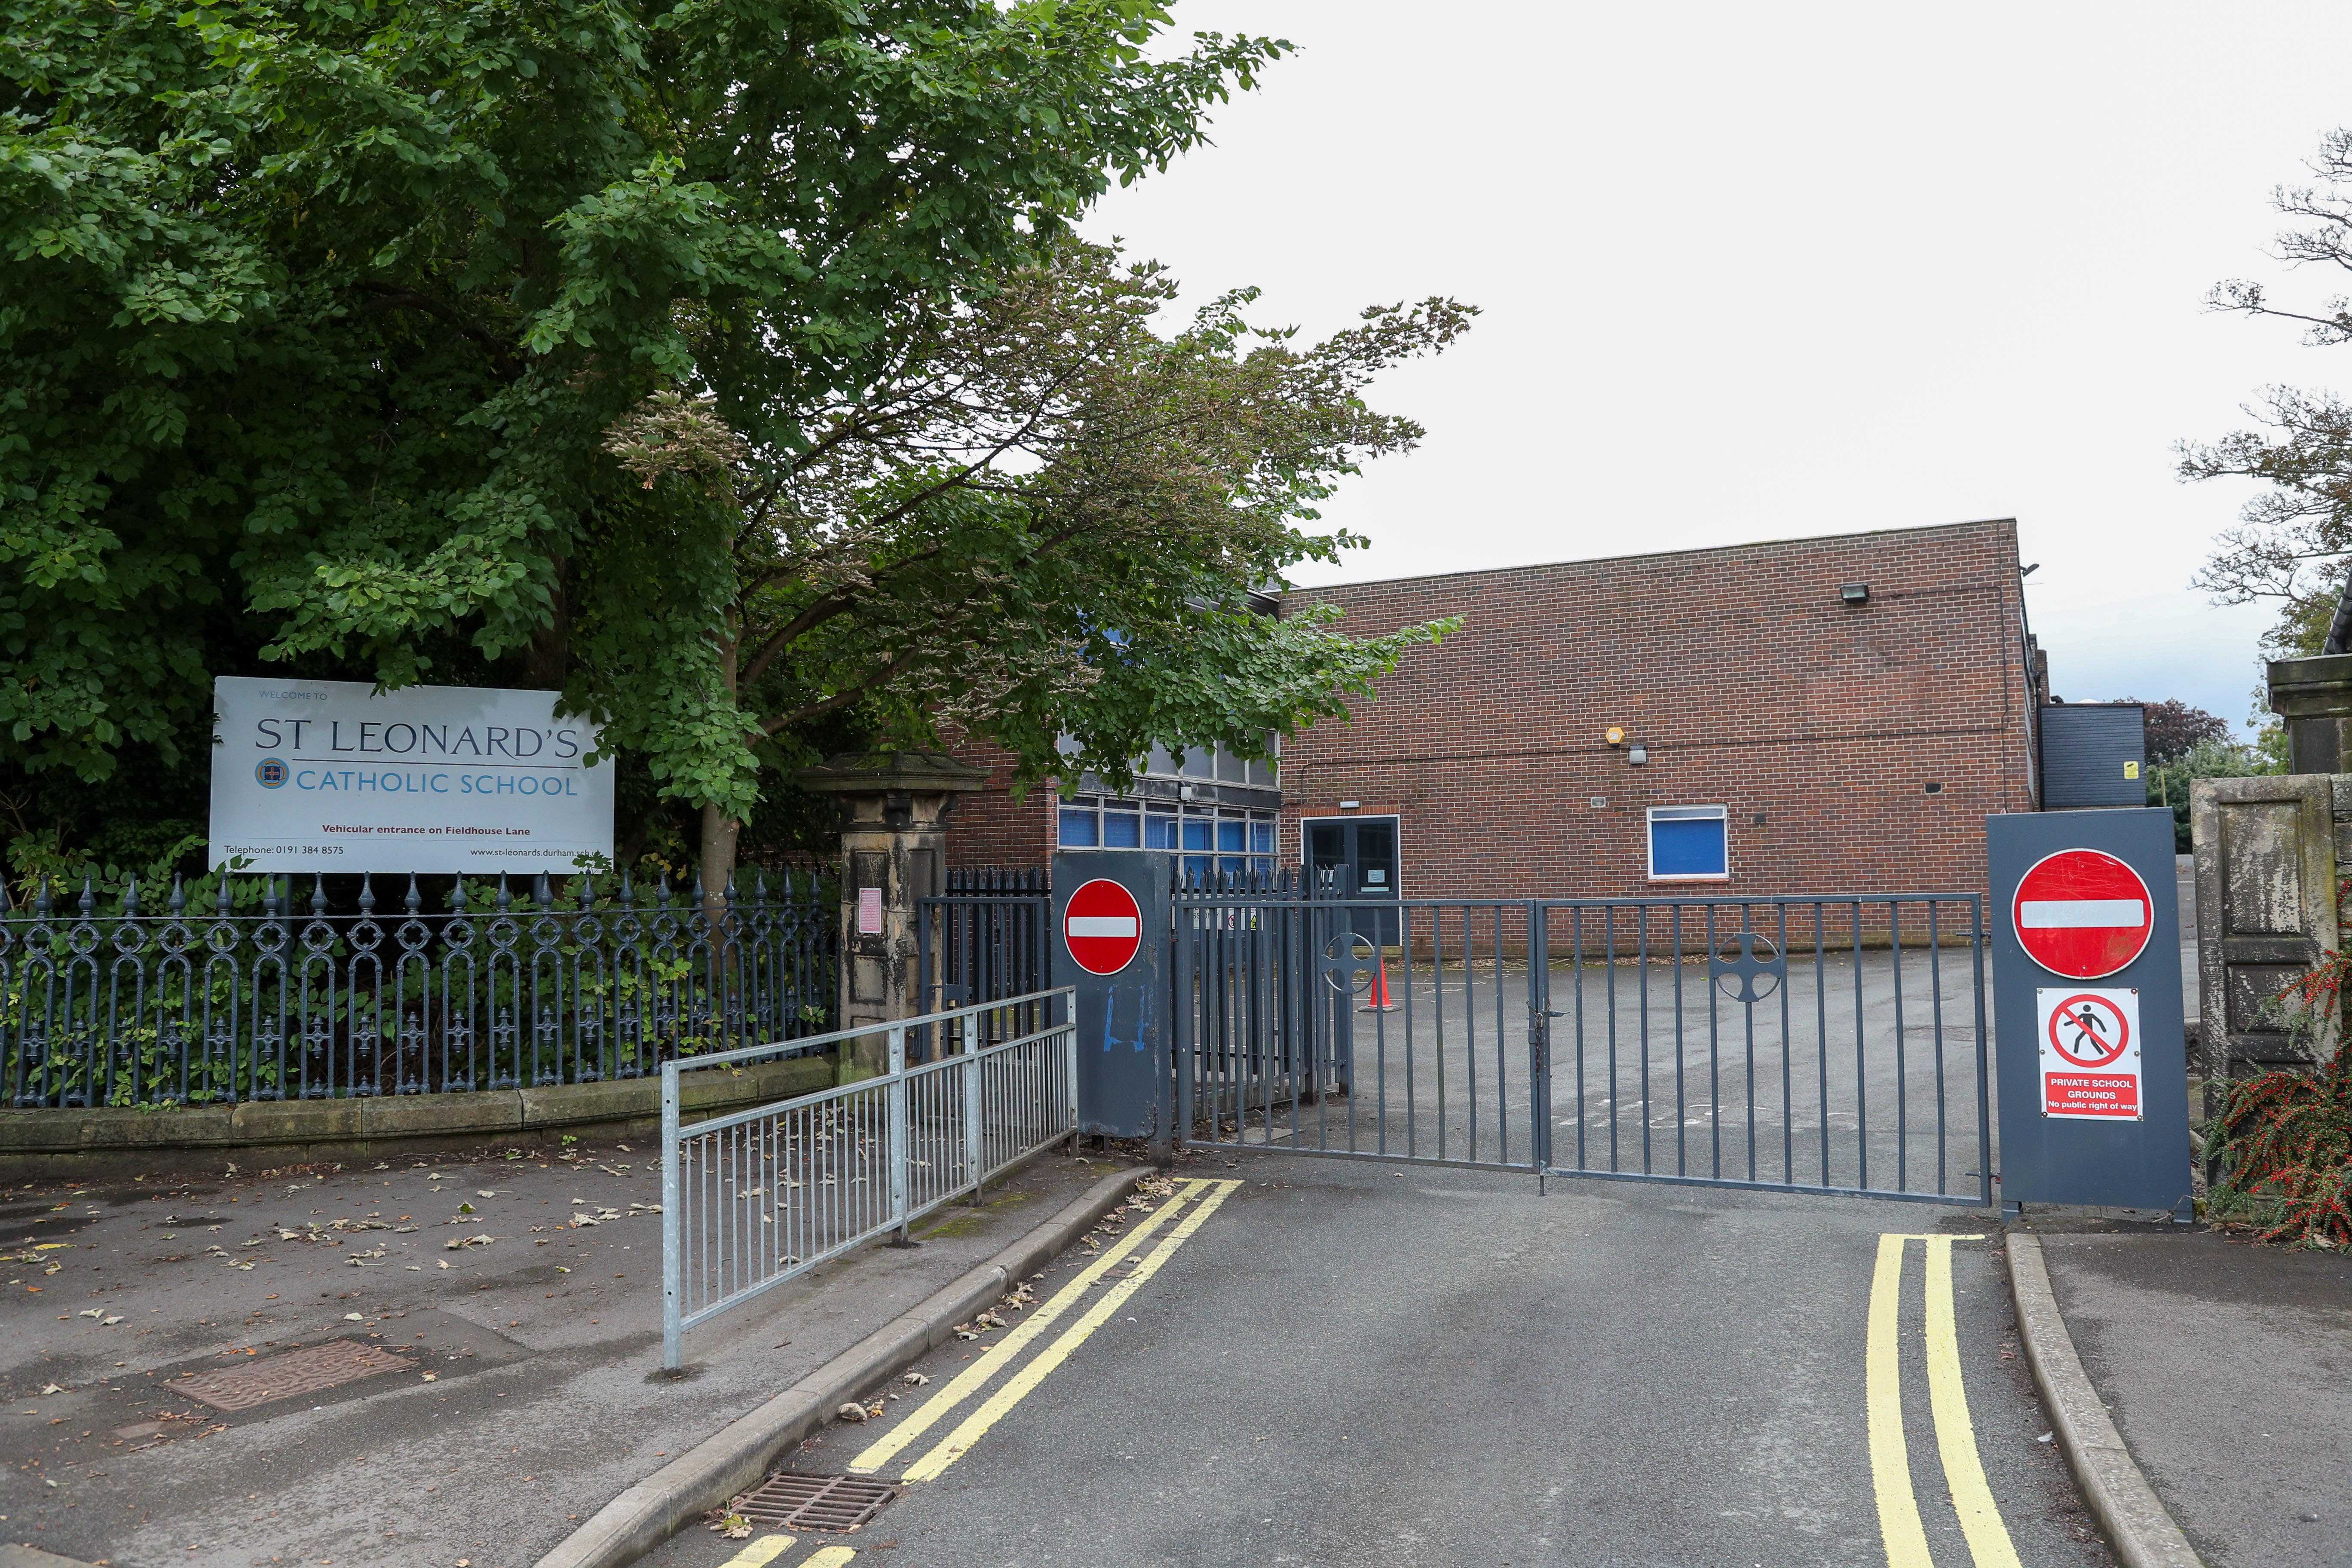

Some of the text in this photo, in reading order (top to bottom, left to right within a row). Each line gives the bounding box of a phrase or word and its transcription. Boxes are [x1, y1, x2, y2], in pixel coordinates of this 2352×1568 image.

[259, 691, 311, 700] WELCOME
[255, 718, 578, 761] ST LEONARD'S
[297, 770, 578, 796] CATHOLIC SCHOOL
[322, 824, 374, 833] Vehicular
[445, 827, 502, 835] Fieldhouse
[224, 845, 344, 855] Telephone: 0191 384 8575
[2051, 1078, 2133, 1088] PRIVATE SCHOOL
[2067, 1090, 2116, 1099] GROUNDS
[2089, 1102, 2108, 1111] right
